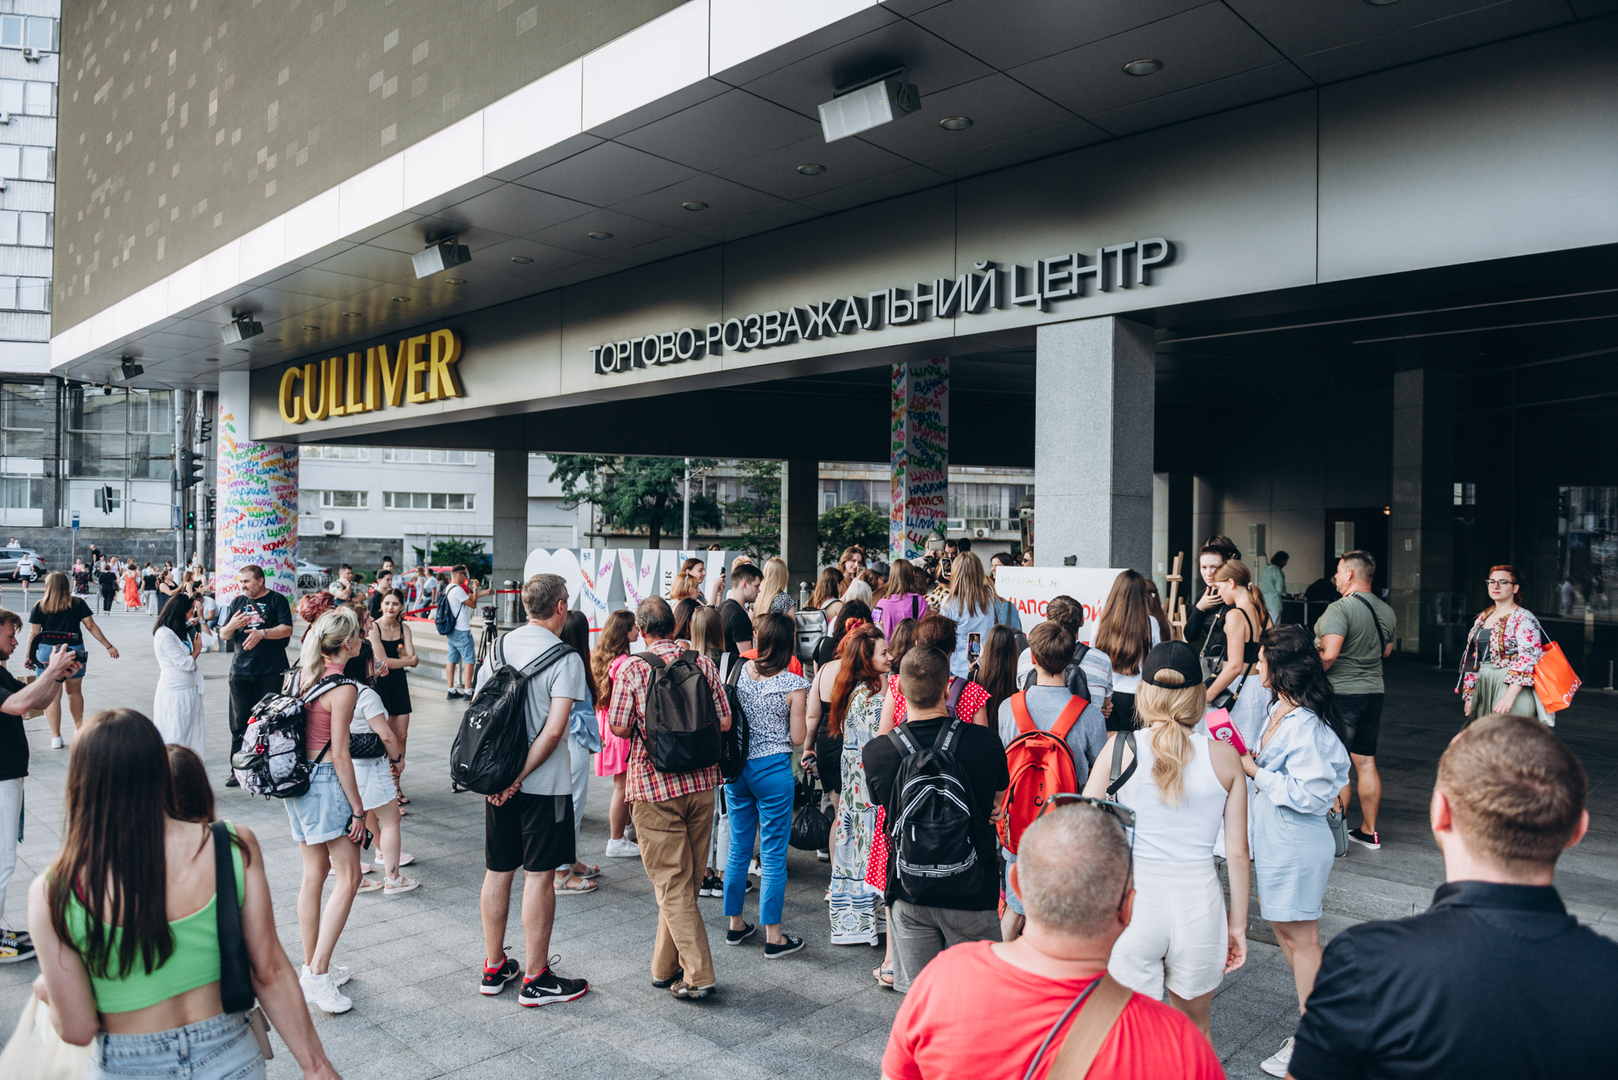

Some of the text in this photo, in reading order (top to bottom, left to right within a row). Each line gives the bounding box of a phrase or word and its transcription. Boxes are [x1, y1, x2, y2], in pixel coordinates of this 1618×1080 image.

[588, 237, 1172, 374] ТОРГОВО-РОЗВАЖАЛЬНИЙ ЦЕНТР
[279, 328, 462, 424] GULLIVER
[248, 515, 279, 528] КОХАЙ
[229, 546, 255, 555] ТВОРИ
[526, 986, 541, 998] AIR
